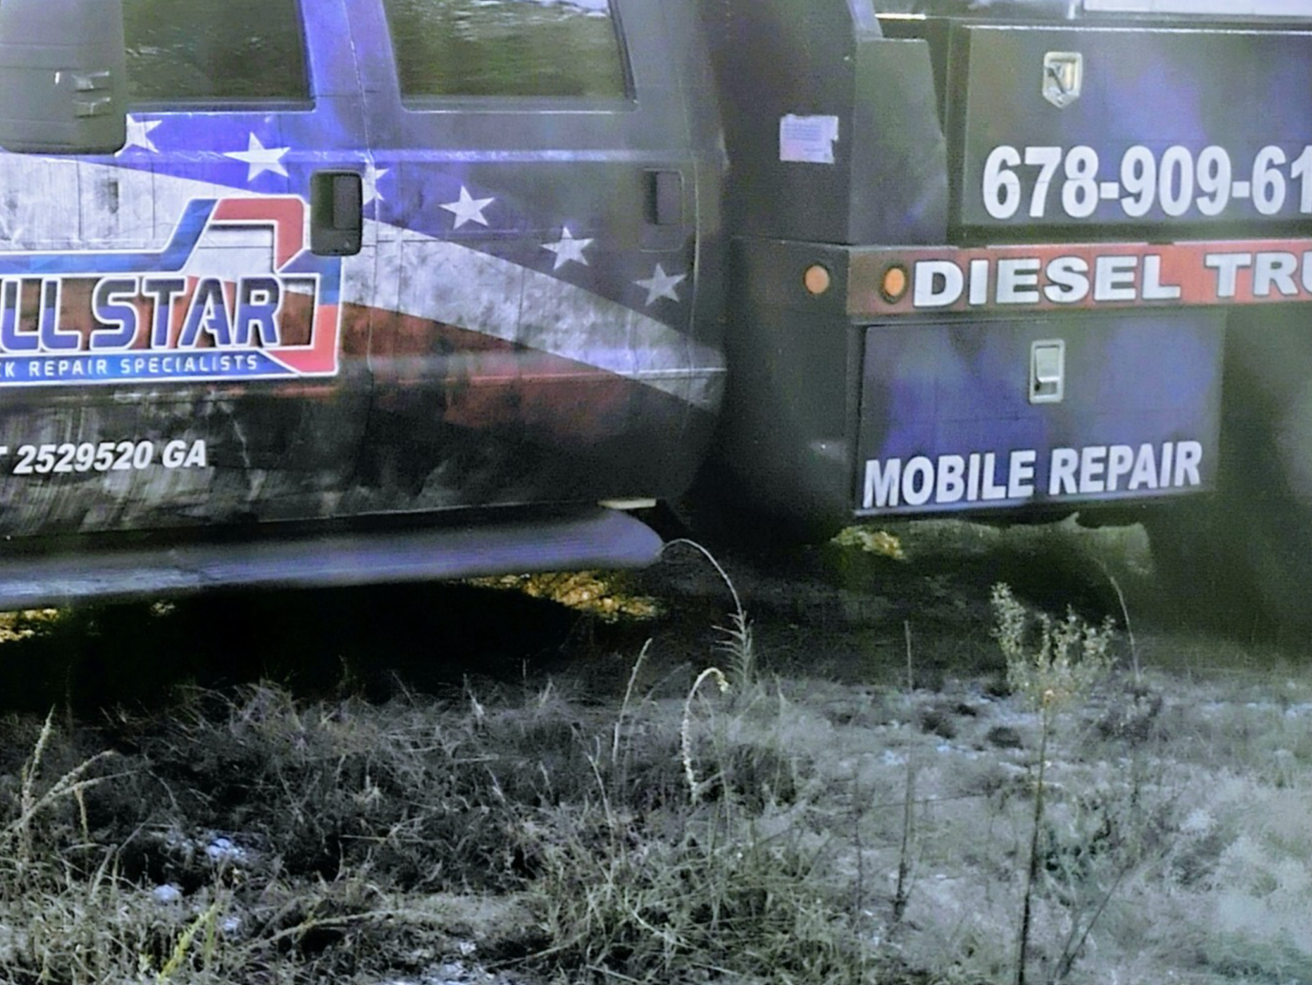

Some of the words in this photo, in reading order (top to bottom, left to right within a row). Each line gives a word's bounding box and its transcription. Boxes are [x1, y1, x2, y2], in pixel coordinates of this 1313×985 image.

[983, 144, 1313, 217] 678-909-61
[914, 254, 1181, 308] DIESEL
[1205, 250, 1313, 299] TR
[29, 358, 107, 377] REPAIR
[120, 354, 258, 374] SPECIALISTS
[12, 440, 155, 475] 2529520
[162, 439, 207, 467] GA
[862, 449, 1037, 510] MOBILE
[1049, 440, 1204, 496] REPAIR
